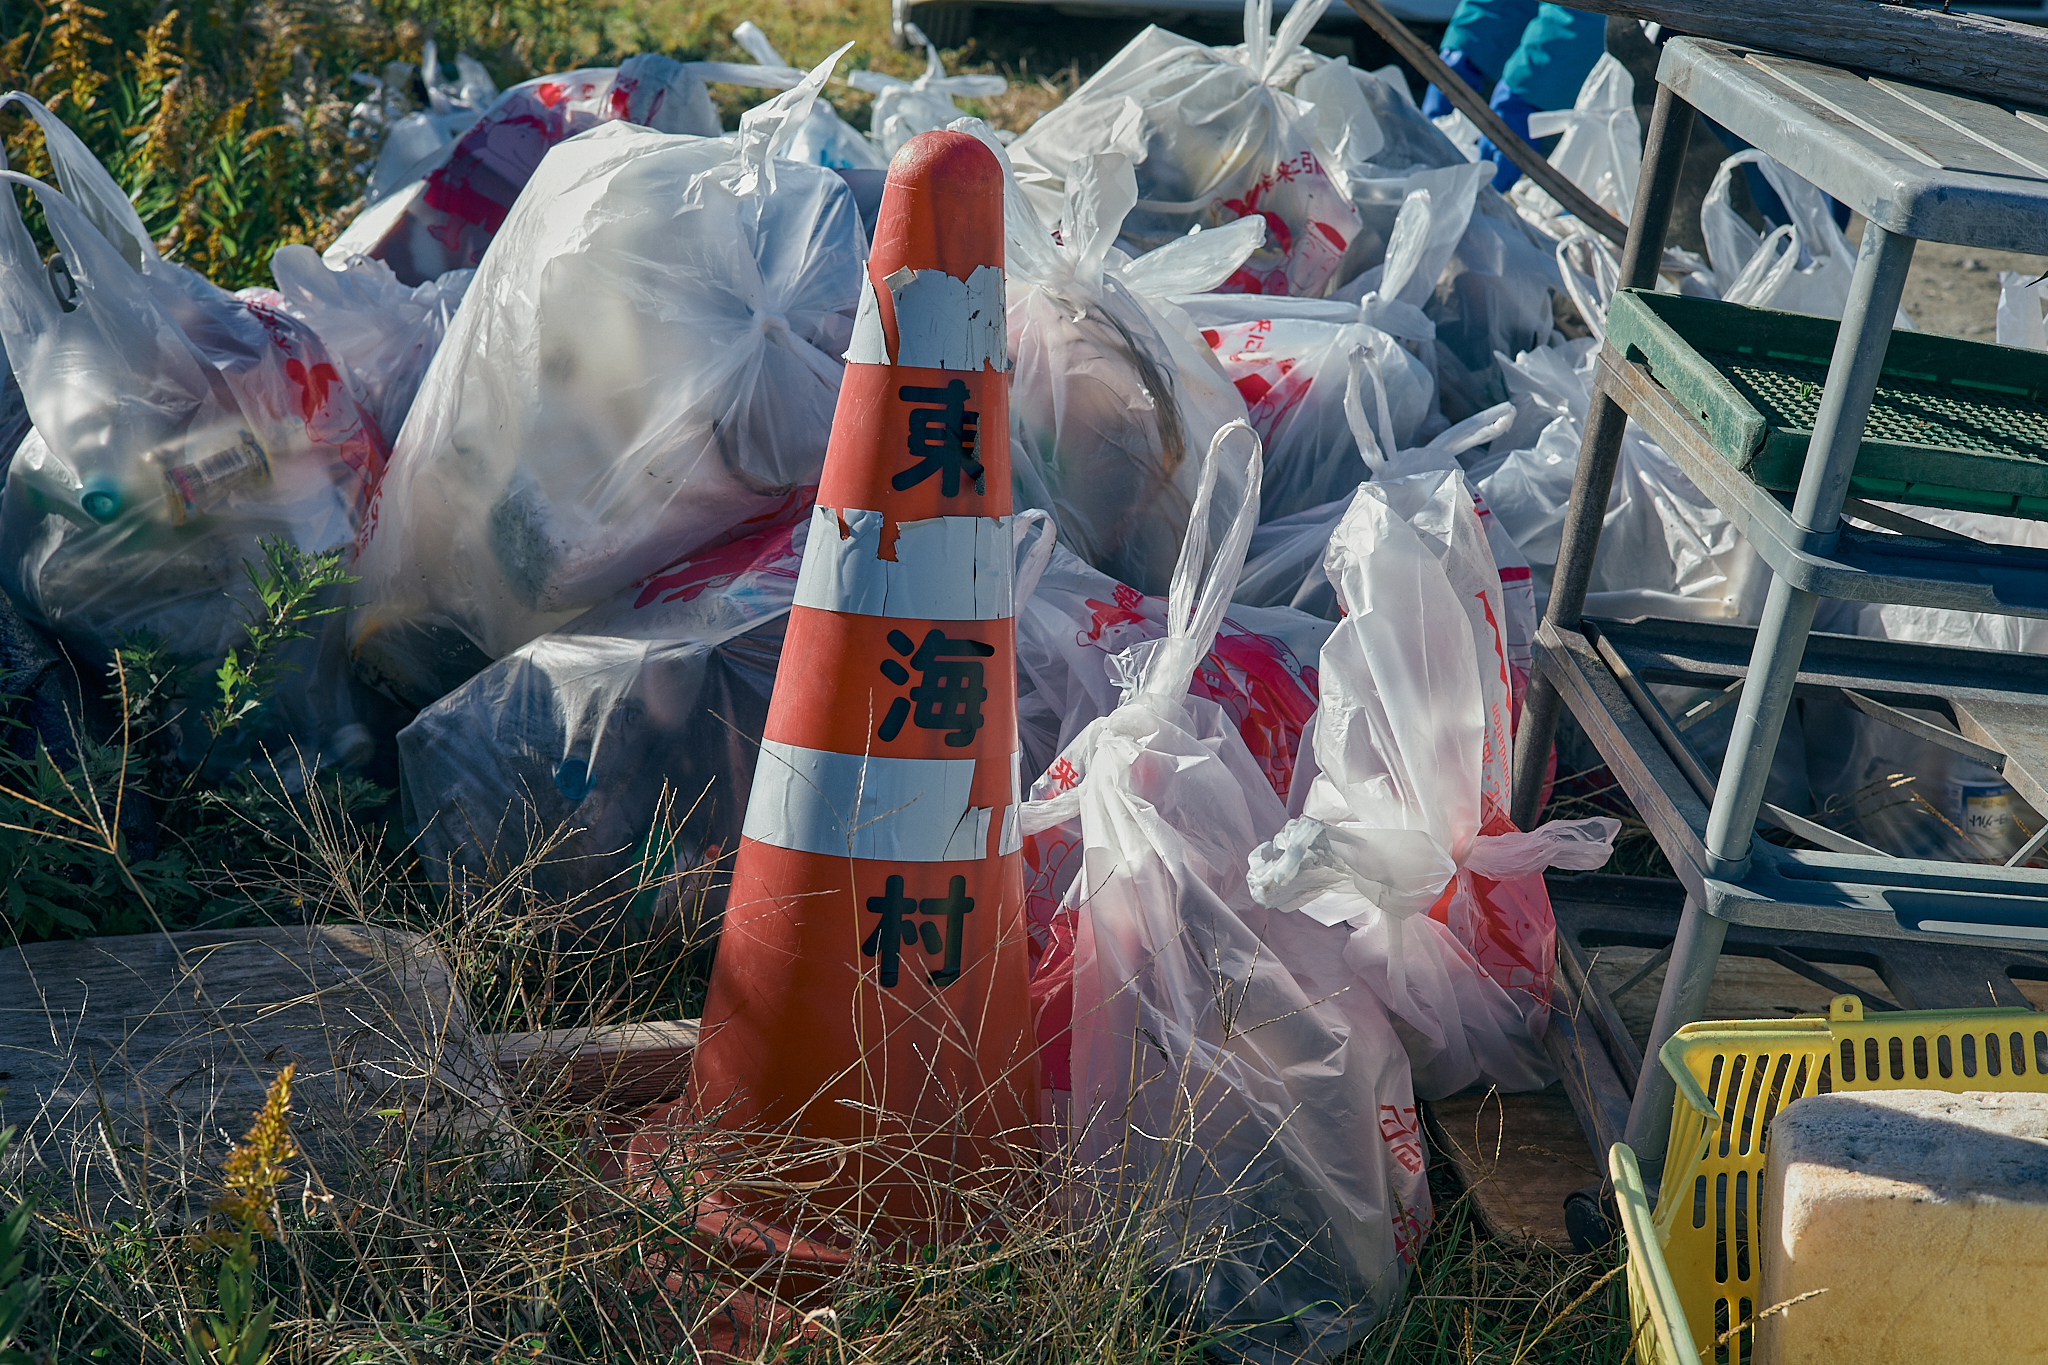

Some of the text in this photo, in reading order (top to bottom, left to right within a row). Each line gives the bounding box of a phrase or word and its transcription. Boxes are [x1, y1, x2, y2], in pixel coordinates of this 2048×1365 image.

[862, 379, 995, 990] 東海村
[1047, 756, 1080, 791] 来
